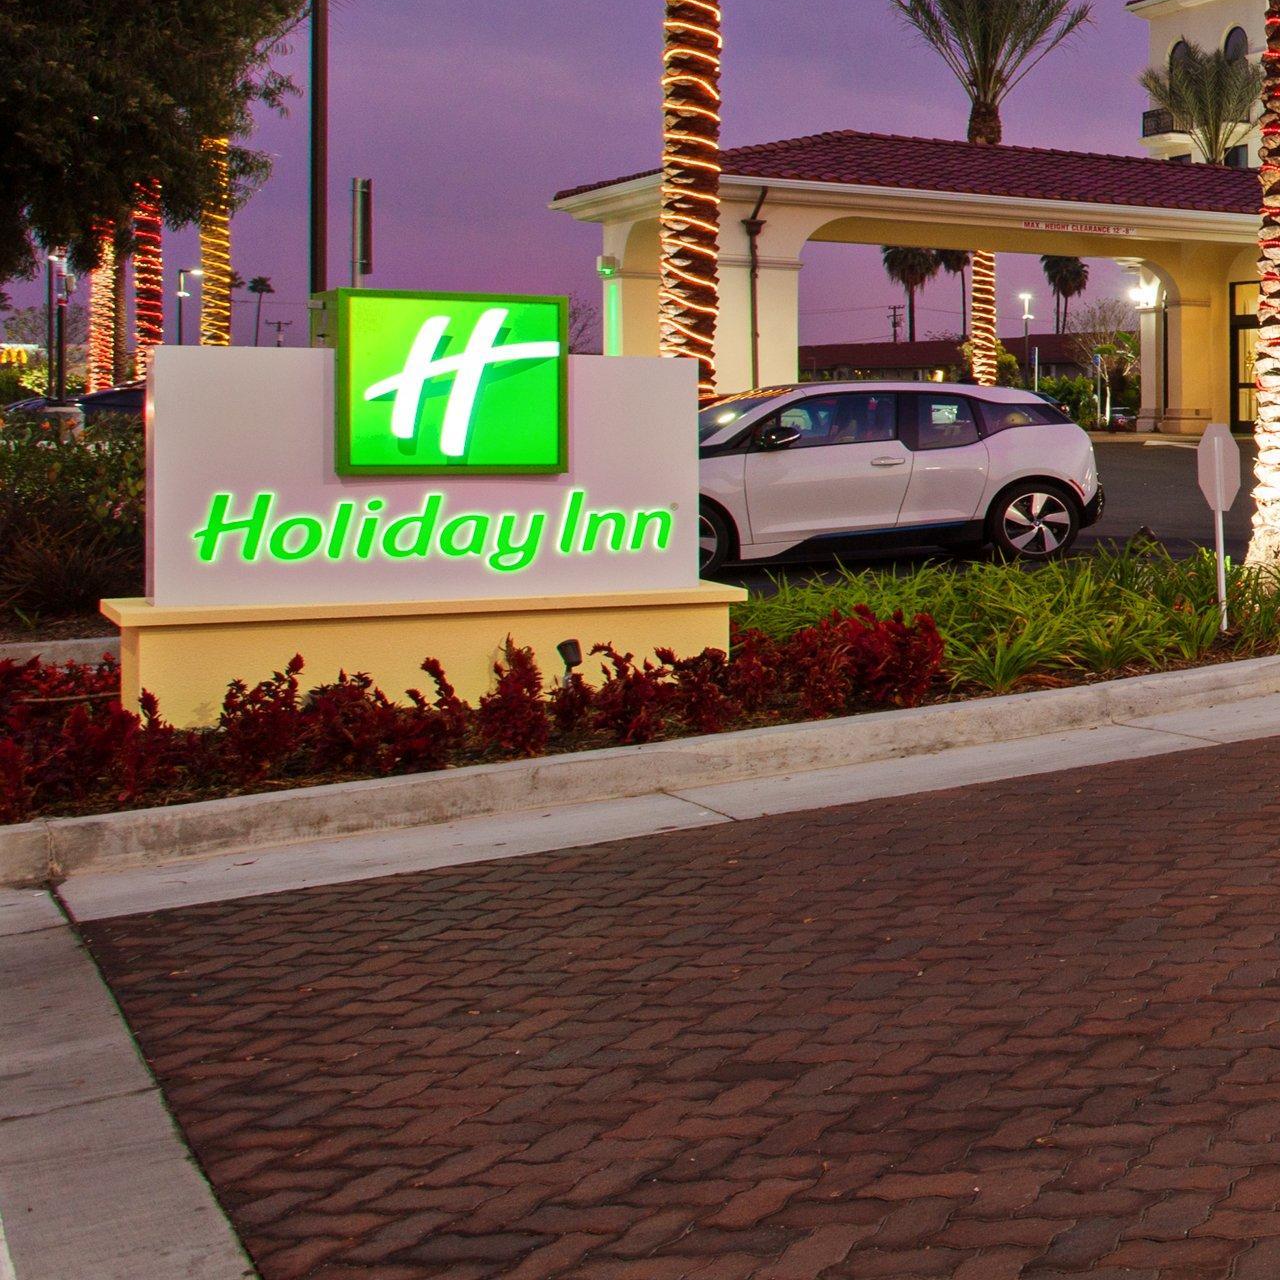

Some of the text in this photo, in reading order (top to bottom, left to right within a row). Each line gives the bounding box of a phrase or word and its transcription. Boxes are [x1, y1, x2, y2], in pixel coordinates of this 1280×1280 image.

[1044, 222, 1070, 231] HEIGHT
[1071, 224, 1111, 233] CLEARANCE
[193, 490, 673, 572] Holiday Inn
